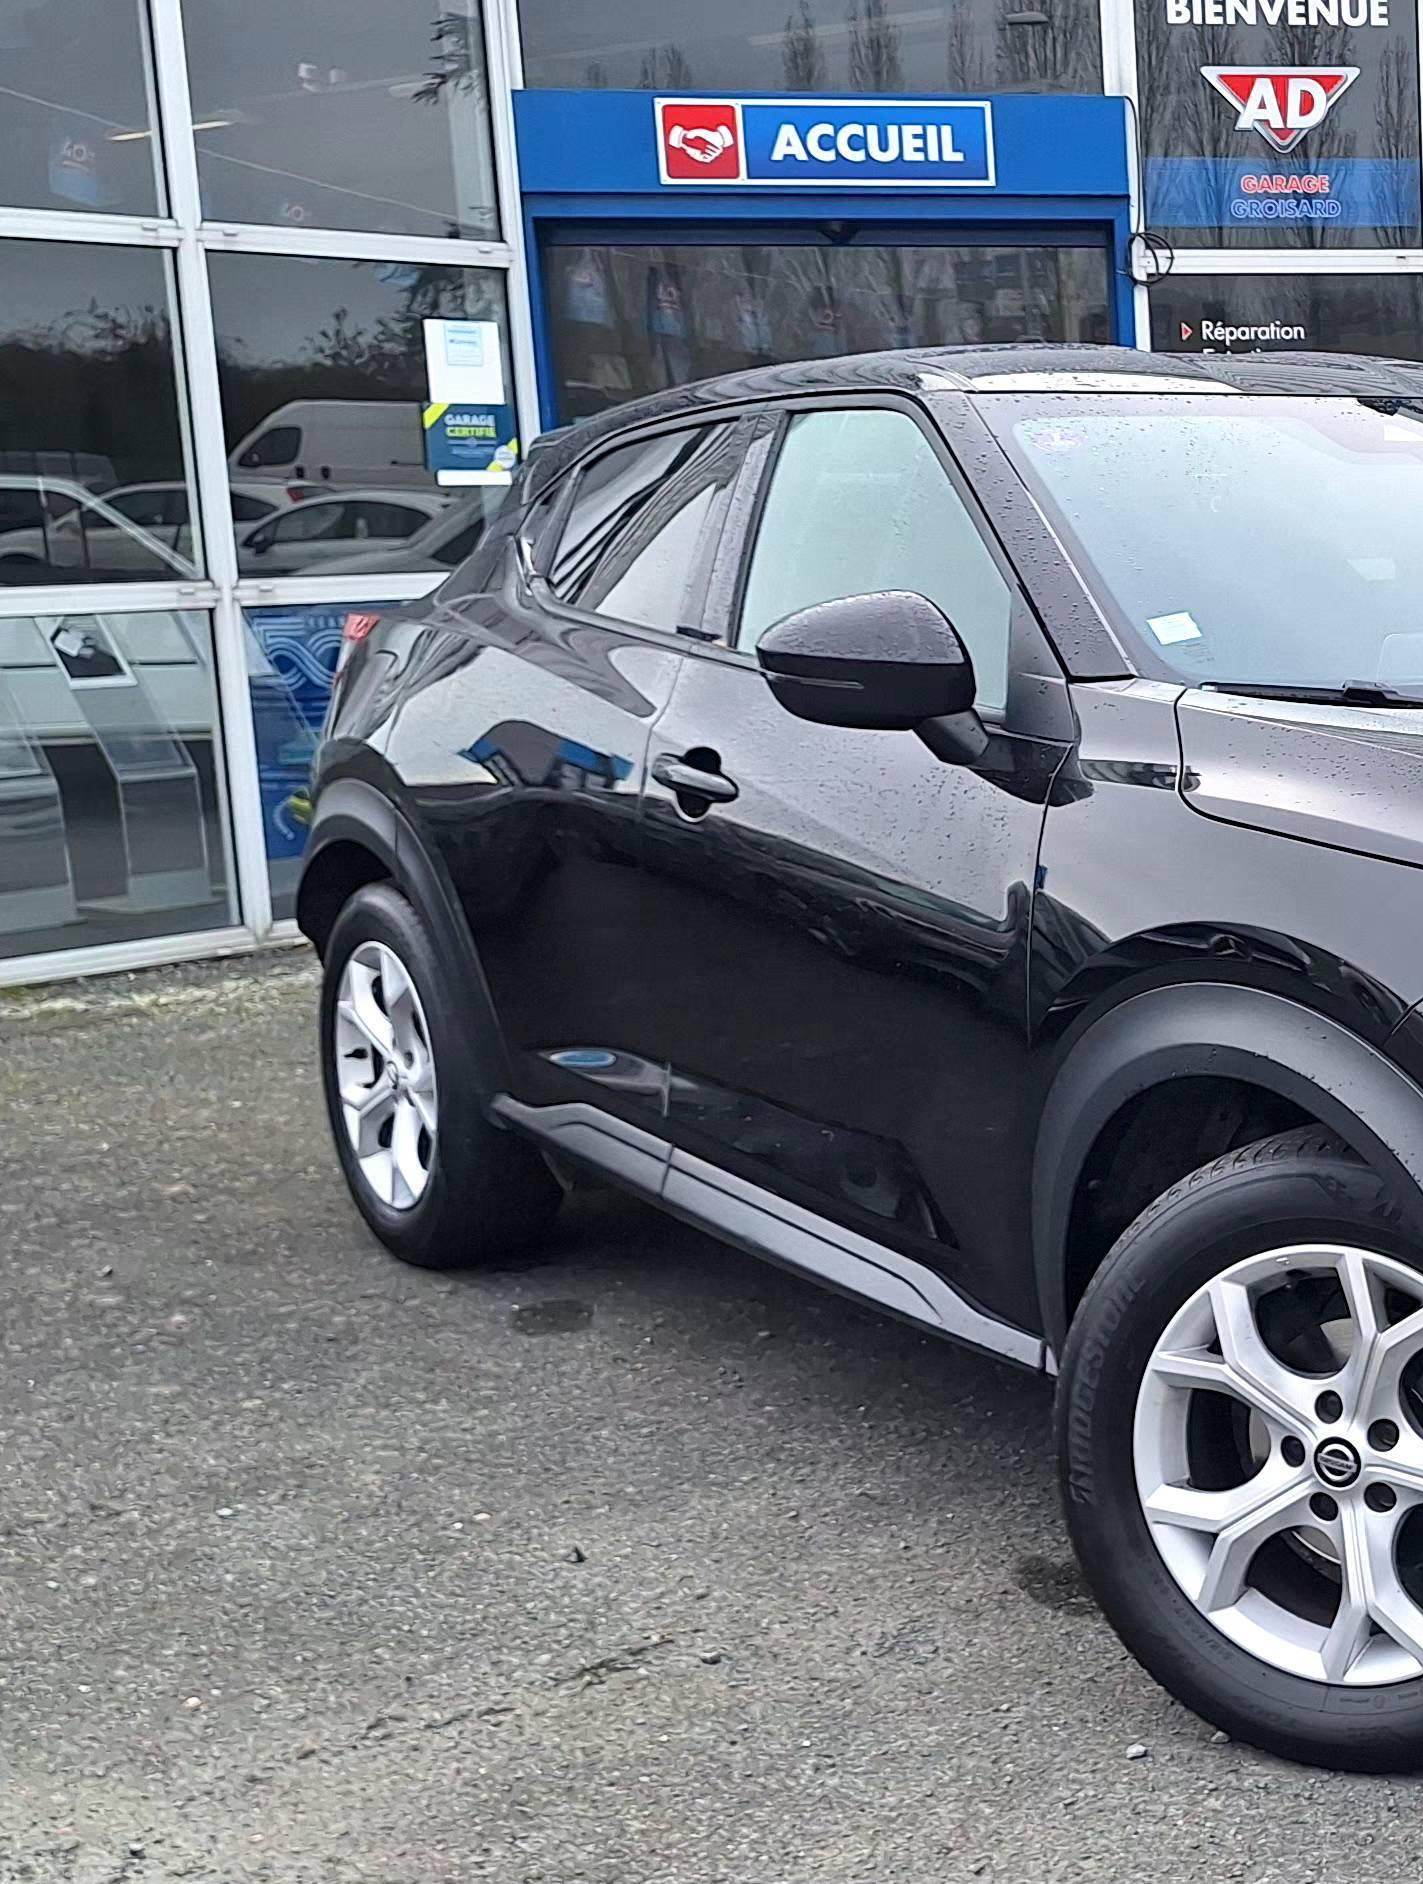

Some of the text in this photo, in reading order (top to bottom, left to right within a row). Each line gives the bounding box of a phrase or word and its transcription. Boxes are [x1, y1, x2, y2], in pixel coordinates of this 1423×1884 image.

[1166, 0, 1389, 26] BIENVENUE
[1235, 78, 1327, 130] AD
[770, 123, 965, 162] ACCUEIL
[1241, 175, 1329, 193] GARAGE
[1231, 199, 1341, 218] GROISARD
[1201, 320, 1305, 346] Réparation
[444, 414, 495, 426] GARAGE
